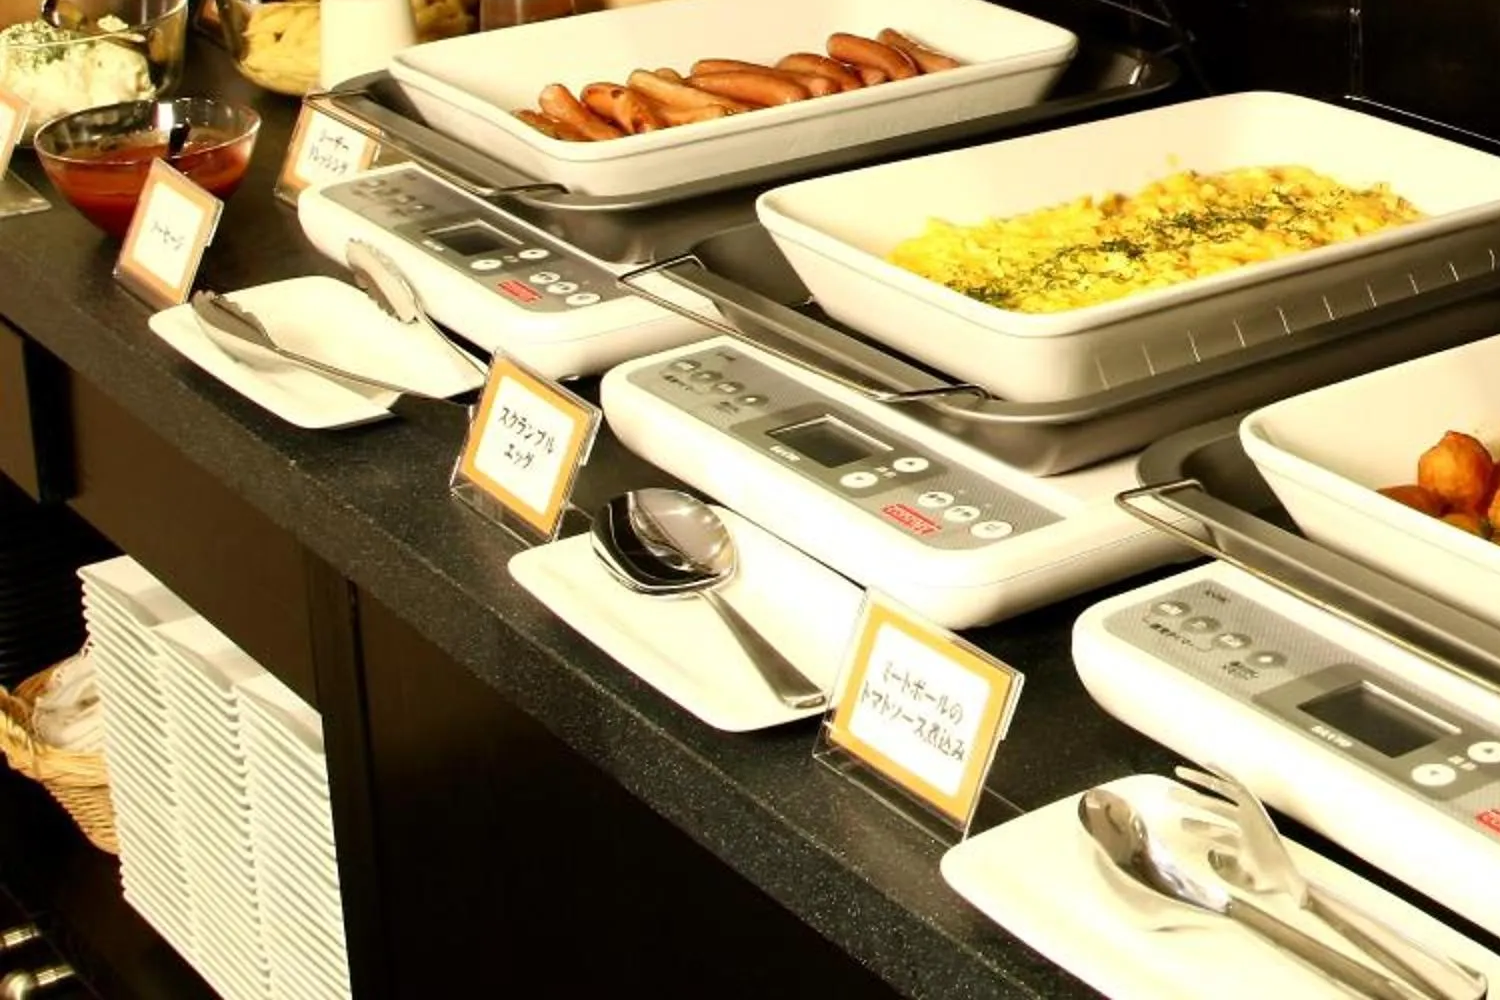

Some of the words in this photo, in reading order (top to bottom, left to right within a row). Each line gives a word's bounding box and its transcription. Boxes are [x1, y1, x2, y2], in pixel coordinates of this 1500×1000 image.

[499, 404, 556, 455] スクランブル
[503, 444, 535, 470] エッグ
[859, 679, 966, 762] トマトソース煮込み
[882, 660, 964, 726] ミートボールの
